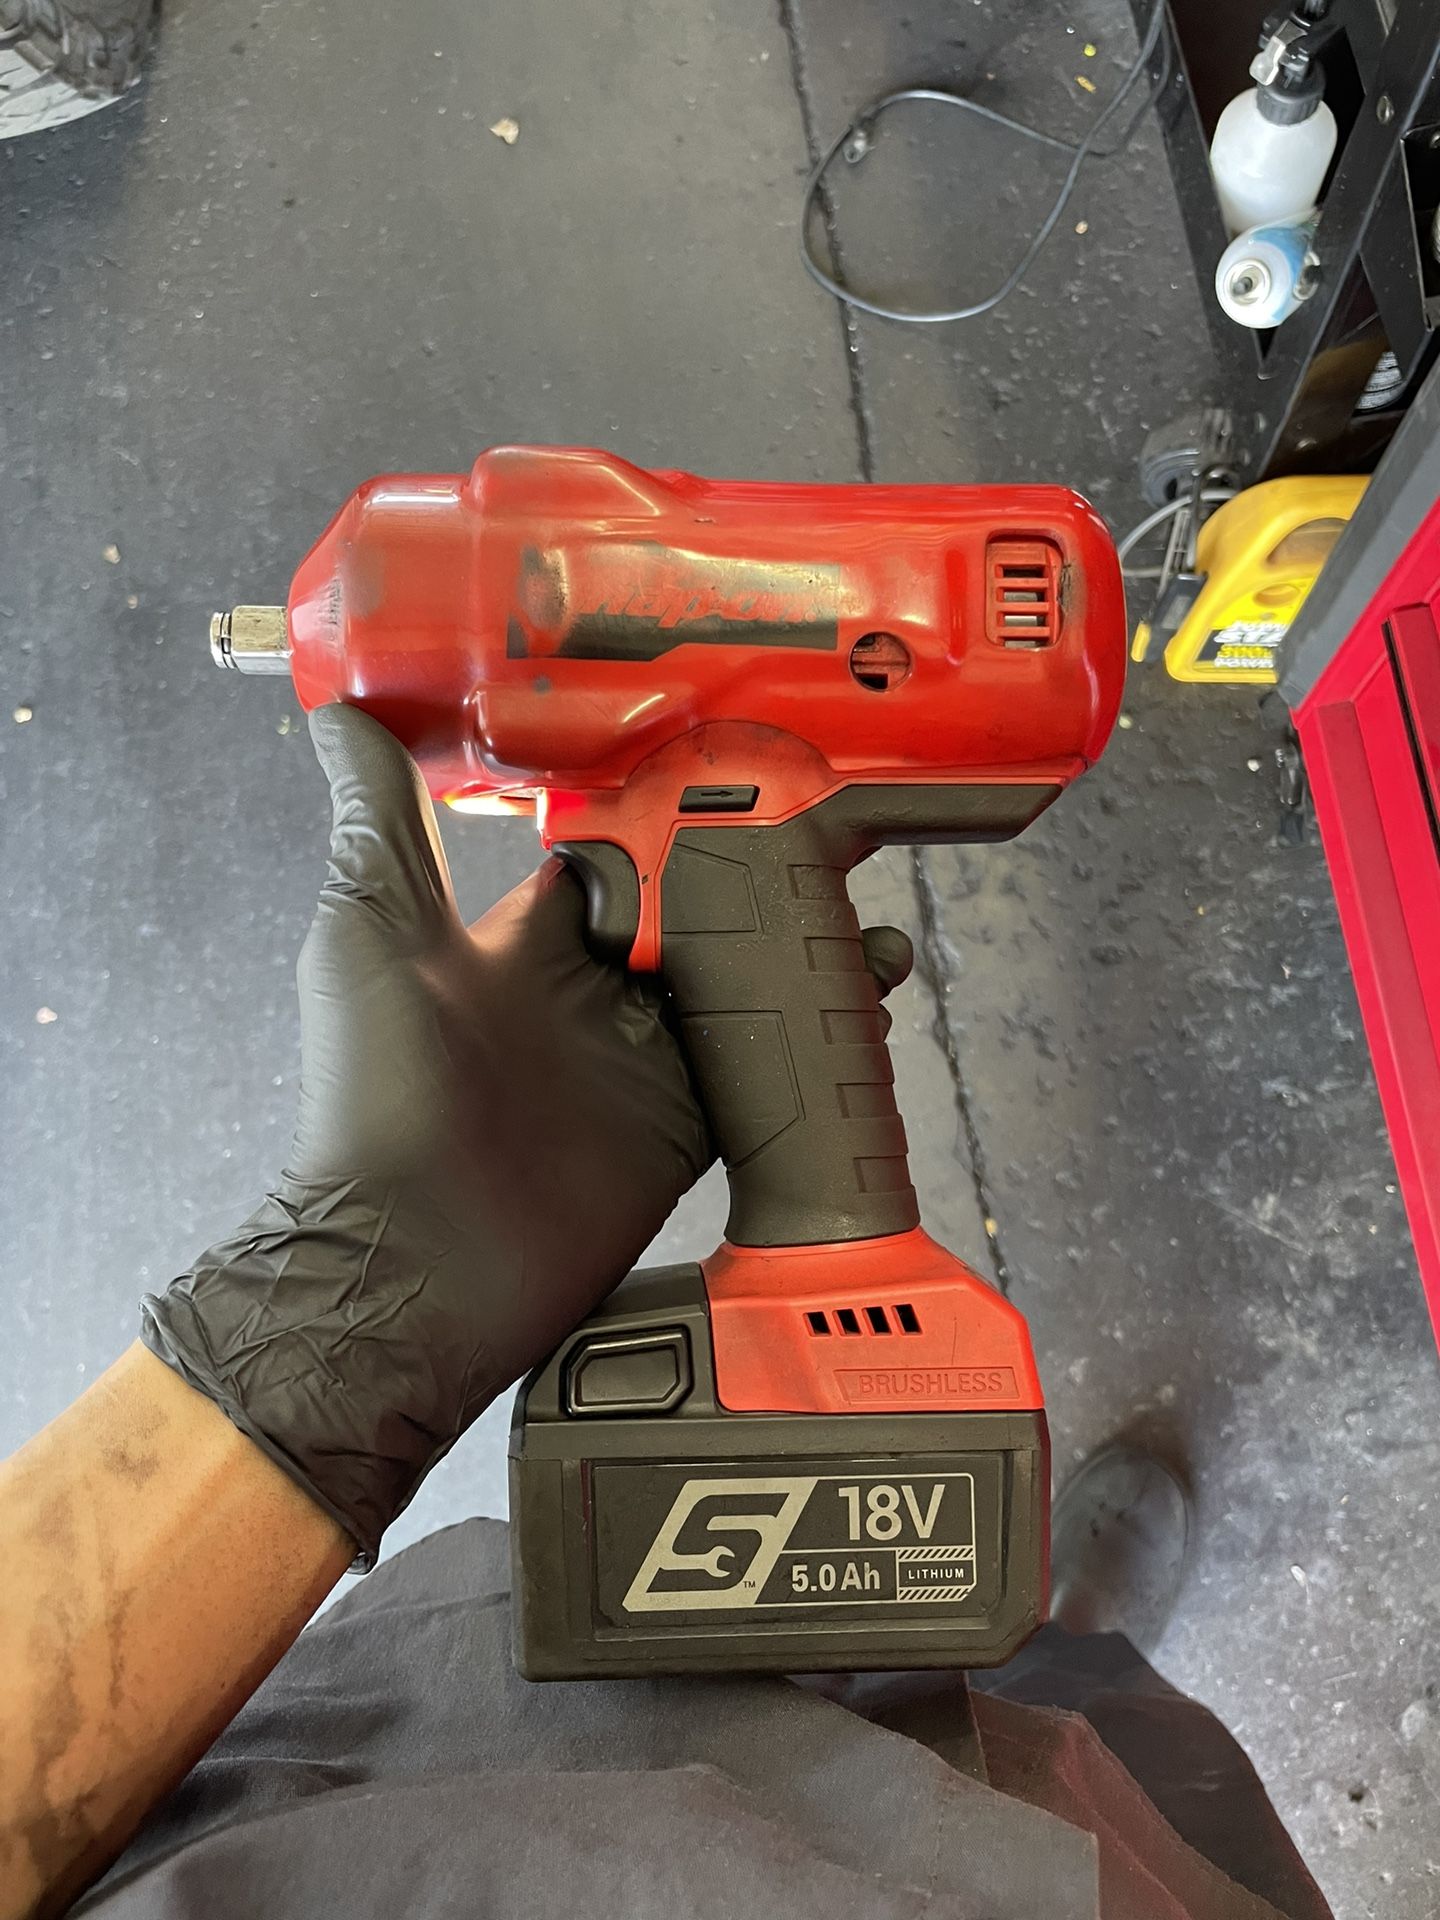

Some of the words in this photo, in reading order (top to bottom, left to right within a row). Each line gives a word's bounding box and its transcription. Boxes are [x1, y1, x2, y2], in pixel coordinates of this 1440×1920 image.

[858, 1372, 1004, 1395] BRUSHLESS
[838, 1484, 946, 1541] 18V
[908, 1568, 964, 1580] LITHIUM
